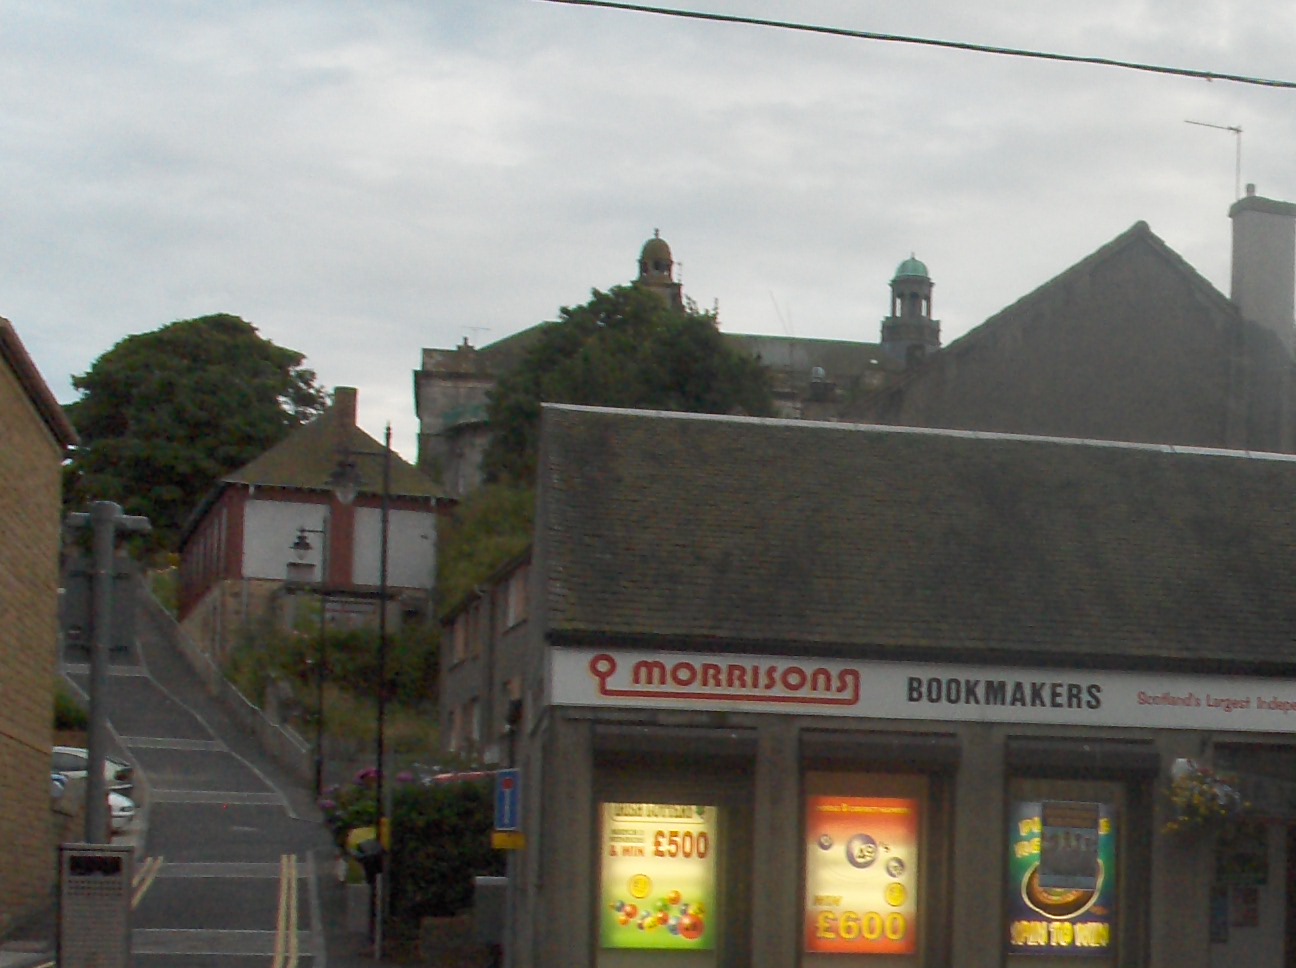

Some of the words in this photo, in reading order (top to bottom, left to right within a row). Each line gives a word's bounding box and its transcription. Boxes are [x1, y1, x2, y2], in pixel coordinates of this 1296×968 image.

[631, 658, 860, 702] MORRISONS
[907, 676, 1103, 710] BOOKMAKERS
[653, 829, 710, 859] £500
[815, 909, 908, 941] £600
